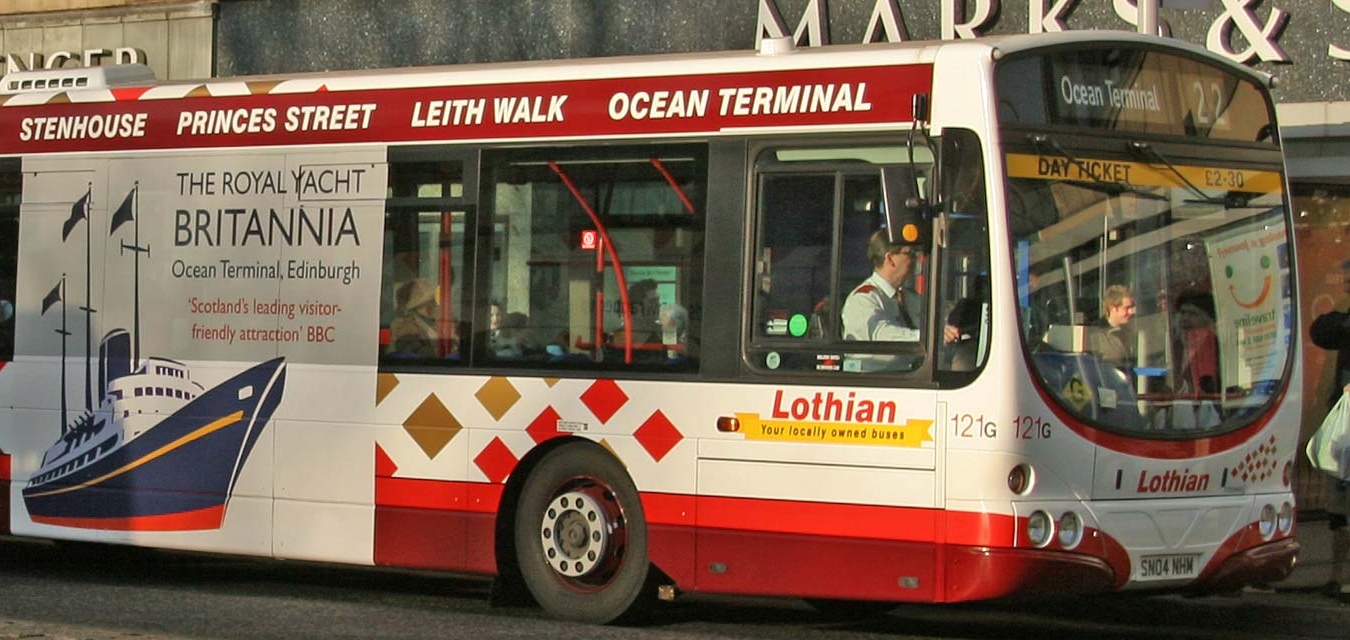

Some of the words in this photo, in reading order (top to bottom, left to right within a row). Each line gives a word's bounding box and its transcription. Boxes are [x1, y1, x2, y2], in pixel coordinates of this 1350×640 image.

[607, 88, 709, 121] OCEAN
[718, 82, 872, 117] TERMINAL
[1060, 75, 1104, 107] Ocean
[1105, 79, 1161, 112] Terminal
[176, 106, 277, 136] PRINCES
[284, 103, 377, 132] STREET
[410, 98, 486, 128] LEITH
[492, 94, 569, 124] WALK
[19, 112, 148, 142] STENHOUSE
[176, 171, 216, 196] THE
[222, 170, 287, 196] ROYAL
[291, 169, 366, 196] YACHT
[1038, 157, 1070, 177] DAY
[1077, 159, 1132, 184] TICKET
[174, 207, 361, 247] BRITANNIA
[171, 259, 217, 279] Ocean
[220, 259, 284, 281] Terminal,
[287, 259, 361, 285] Edinburgh
[253, 298, 296, 320] leading
[298, 299, 342, 316] visitor-
[191, 323, 237, 344] friendly
[307, 326, 336, 343] BBC
[771, 389, 898, 424] Lothian
[761, 424, 785, 436] Your
[788, 424, 827, 440] locally
[831, 426, 867, 440] owned
[871, 428, 906, 441] buses
[1136, 468, 1210, 493] Lothian
[1140, 559, 1169, 577] SN04
